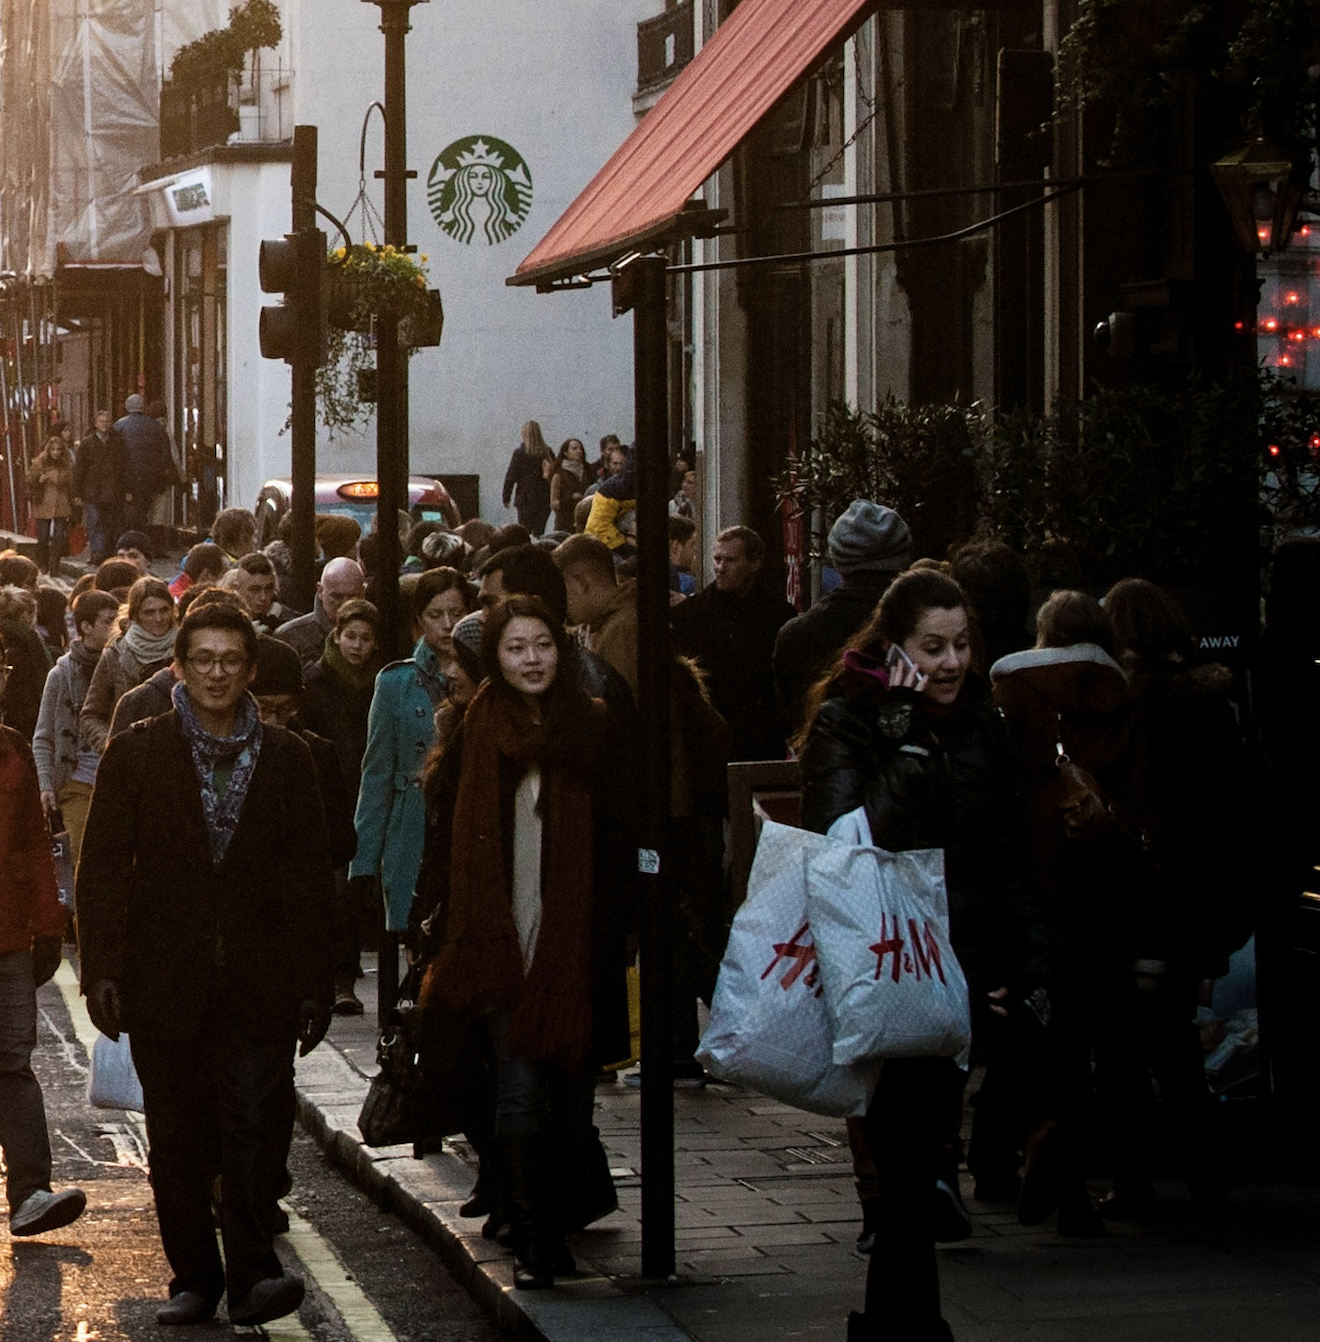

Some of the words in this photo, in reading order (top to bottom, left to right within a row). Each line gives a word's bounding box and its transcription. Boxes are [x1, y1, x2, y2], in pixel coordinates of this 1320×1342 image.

[1200, 636, 1239, 648] AWAY
[761, 921, 824, 998] H&
[868, 912, 948, 986] H&M
